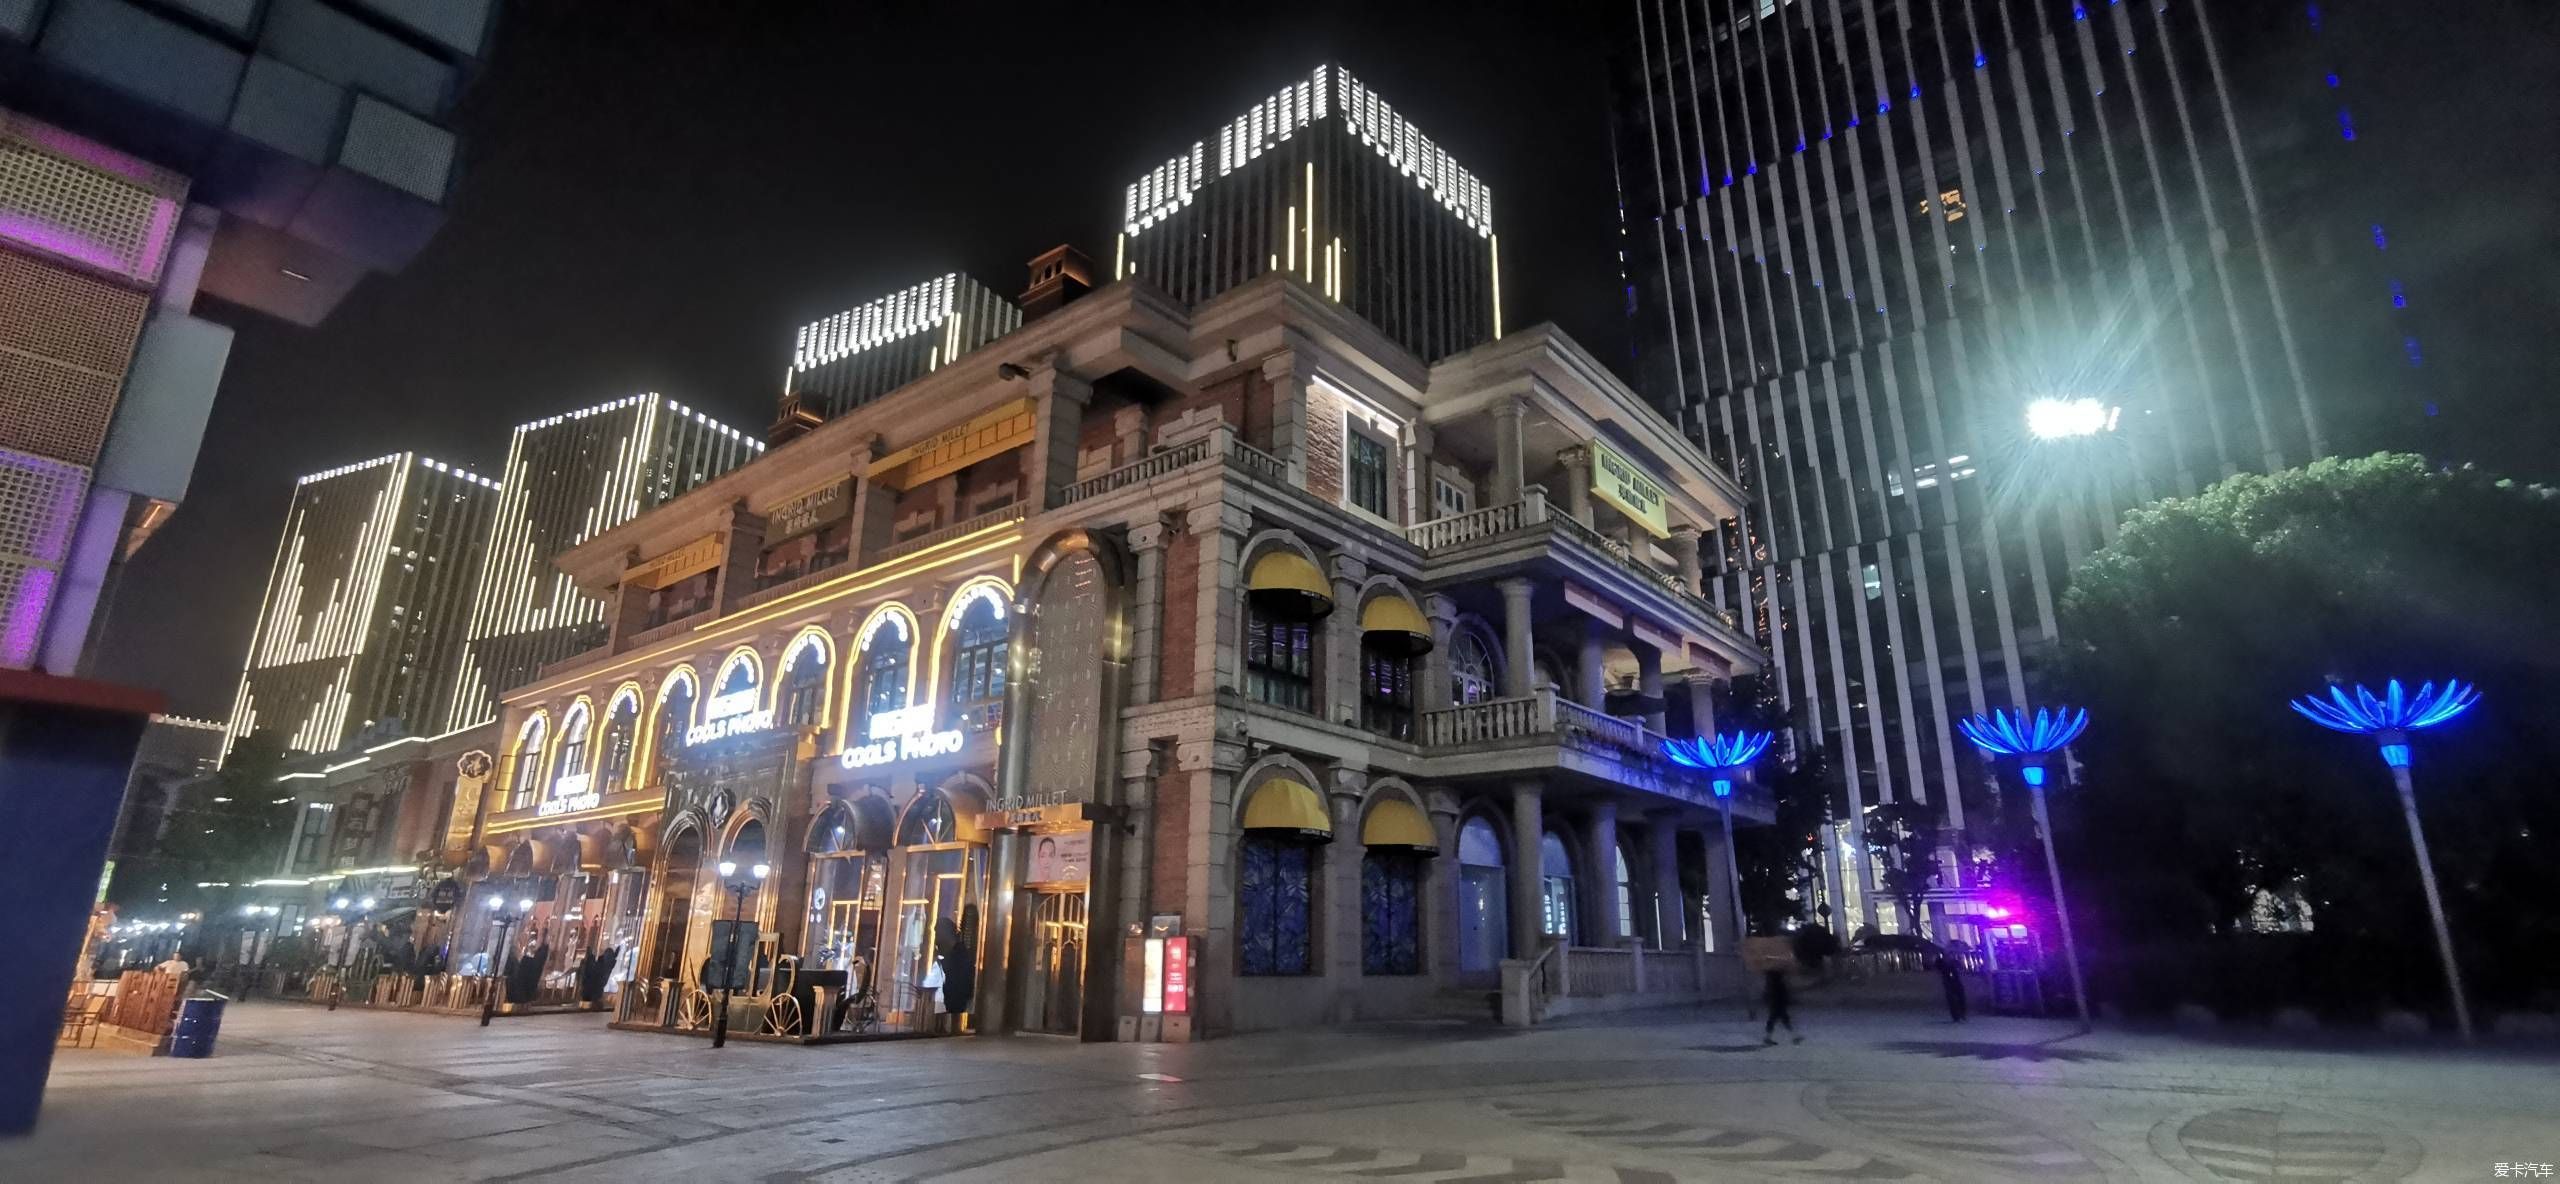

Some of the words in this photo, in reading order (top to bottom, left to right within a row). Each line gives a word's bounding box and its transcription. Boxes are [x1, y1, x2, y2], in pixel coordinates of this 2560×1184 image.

[1601, 454, 1631, 485] INGRID
[1633, 477, 1660, 506] MILLET
[772, 499, 804, 526] INGRID
[806, 485, 839, 509] MILLET
[686, 720, 726, 747] COOLS
[727, 710, 773, 736] PHOTO
[842, 741, 896, 769] COOLS
[901, 730, 963, 761] PHOTO
[538, 799, 568, 816] COOLS
[568, 793, 600, 812] PHOTO
[986, 795, 1024, 812] INGRID
[1026, 790, 1067, 808] MILLET
